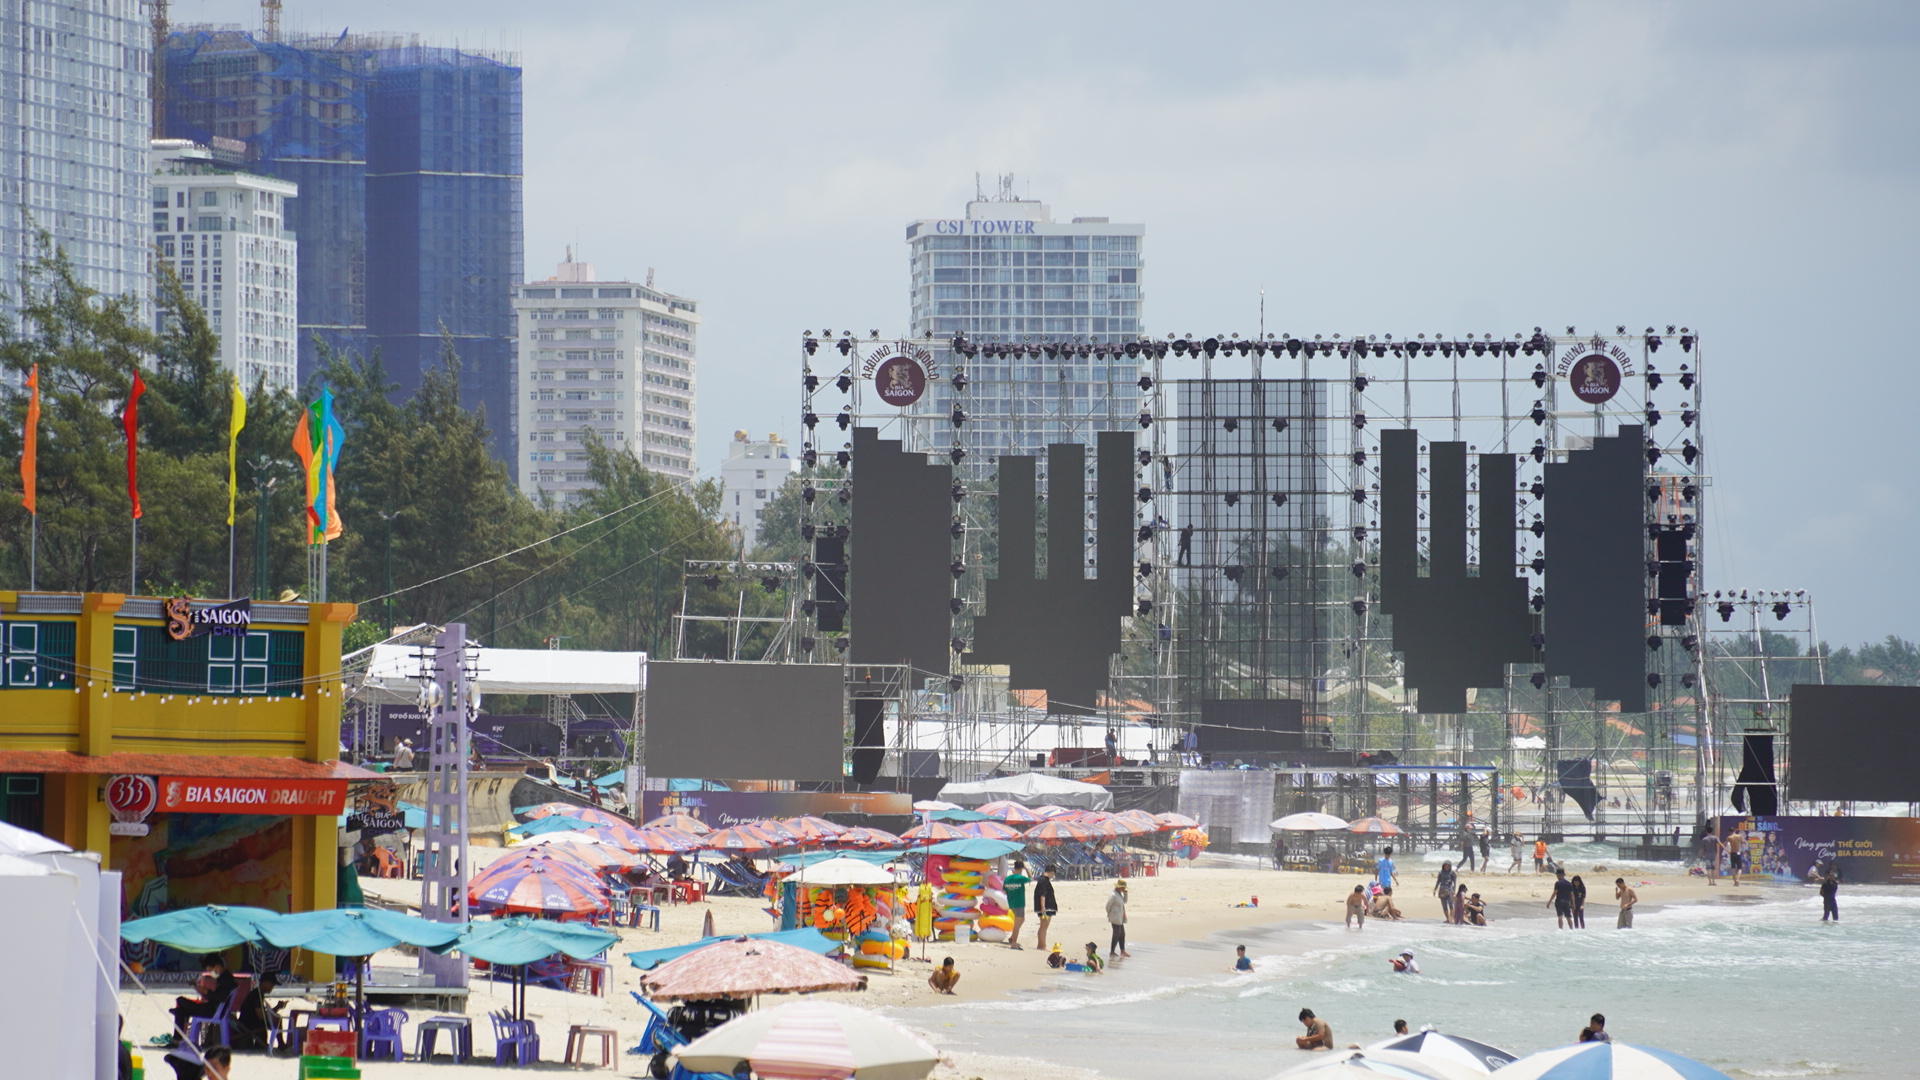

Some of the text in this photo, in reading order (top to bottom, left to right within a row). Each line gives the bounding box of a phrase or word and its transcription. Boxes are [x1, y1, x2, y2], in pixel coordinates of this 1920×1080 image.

[936, 220, 1035, 236] CSJ TOWER
[862, 341, 940, 380] AROUND THE WORLD
[1556, 339, 1635, 378] AROUND THE WORLD
[884, 389, 914, 397] SAIGON
[1579, 386, 1609, 394] SAIGON
[201, 609, 251, 625] SAIGON
[115, 774, 144, 808] 333
[185, 786, 336, 805] BIA SAIGON DRAUGHT
[363, 820, 403, 828] SAIGON
